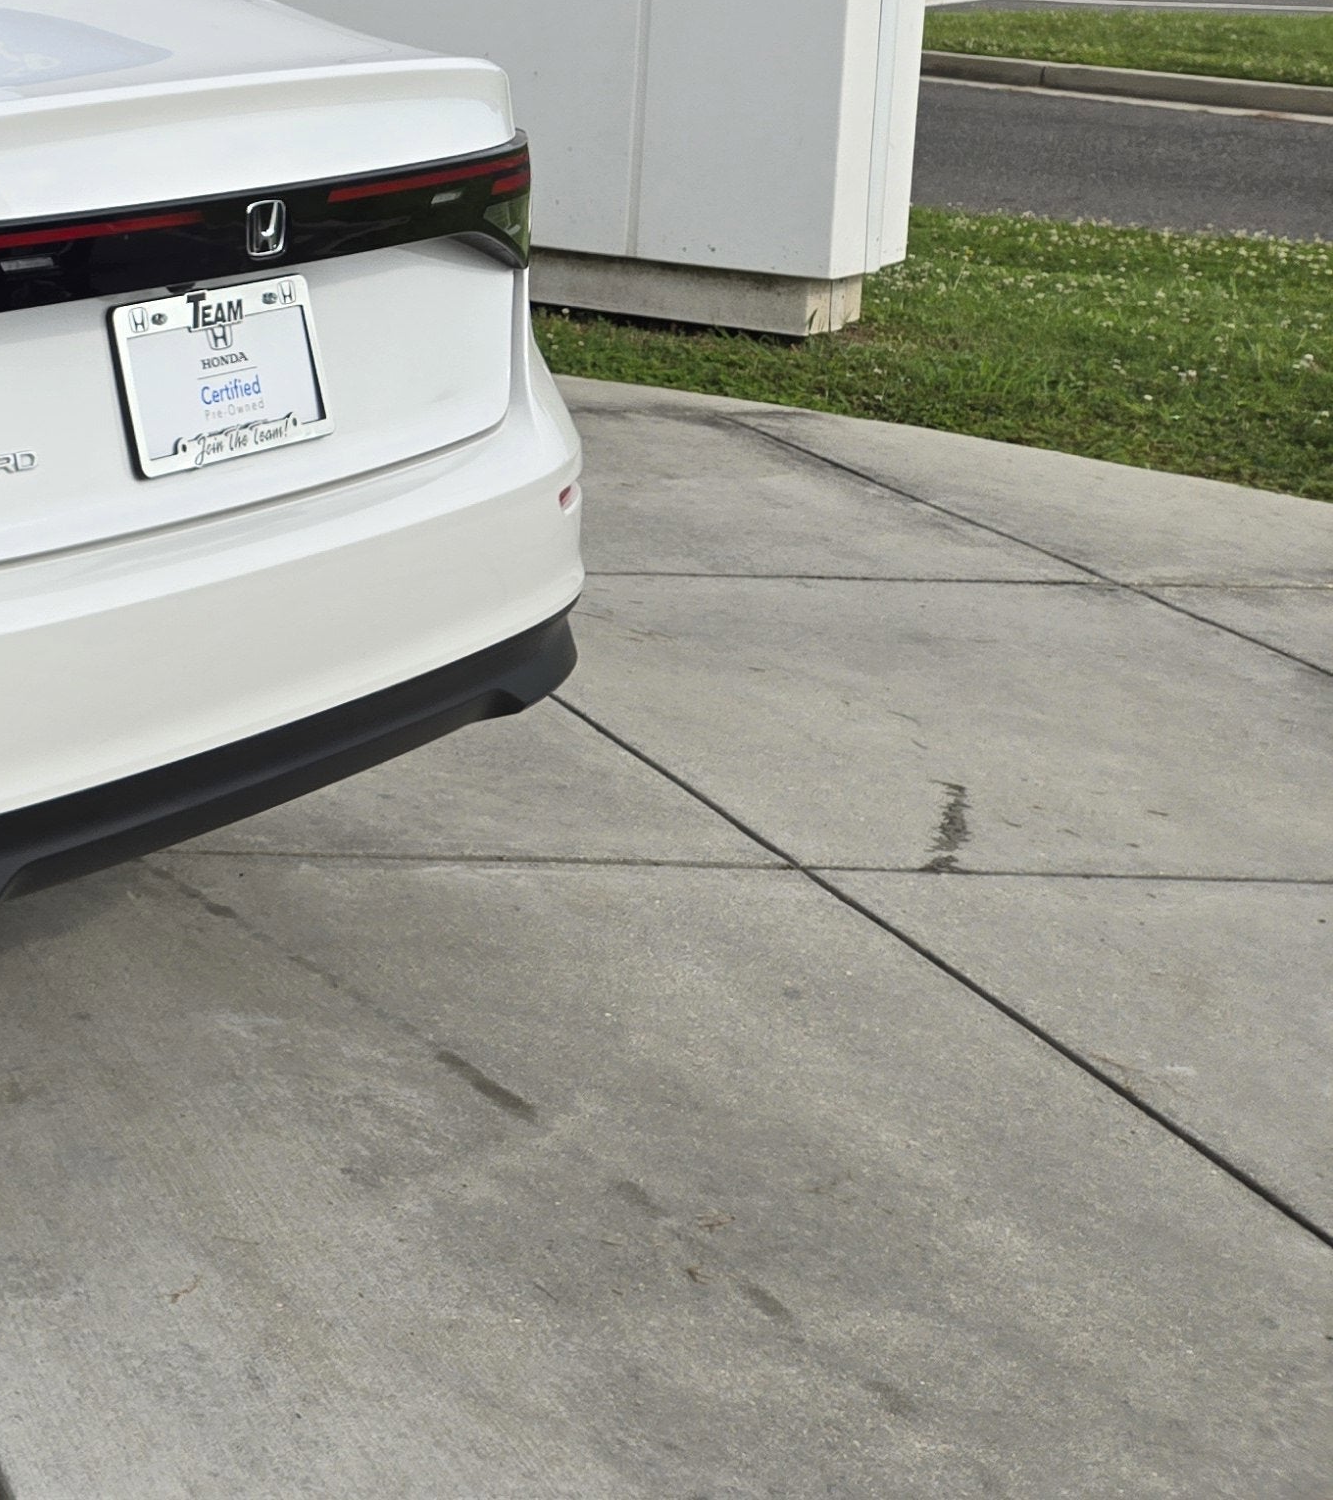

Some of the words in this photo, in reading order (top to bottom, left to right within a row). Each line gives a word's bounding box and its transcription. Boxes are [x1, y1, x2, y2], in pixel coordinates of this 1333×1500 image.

[186, 291, 244, 330] TEAM
[200, 350, 249, 370] HONDA
[200, 374, 262, 406] Certified
[204, 398, 265, 420] Pre-Owned
[194, 435, 224, 466] Join
